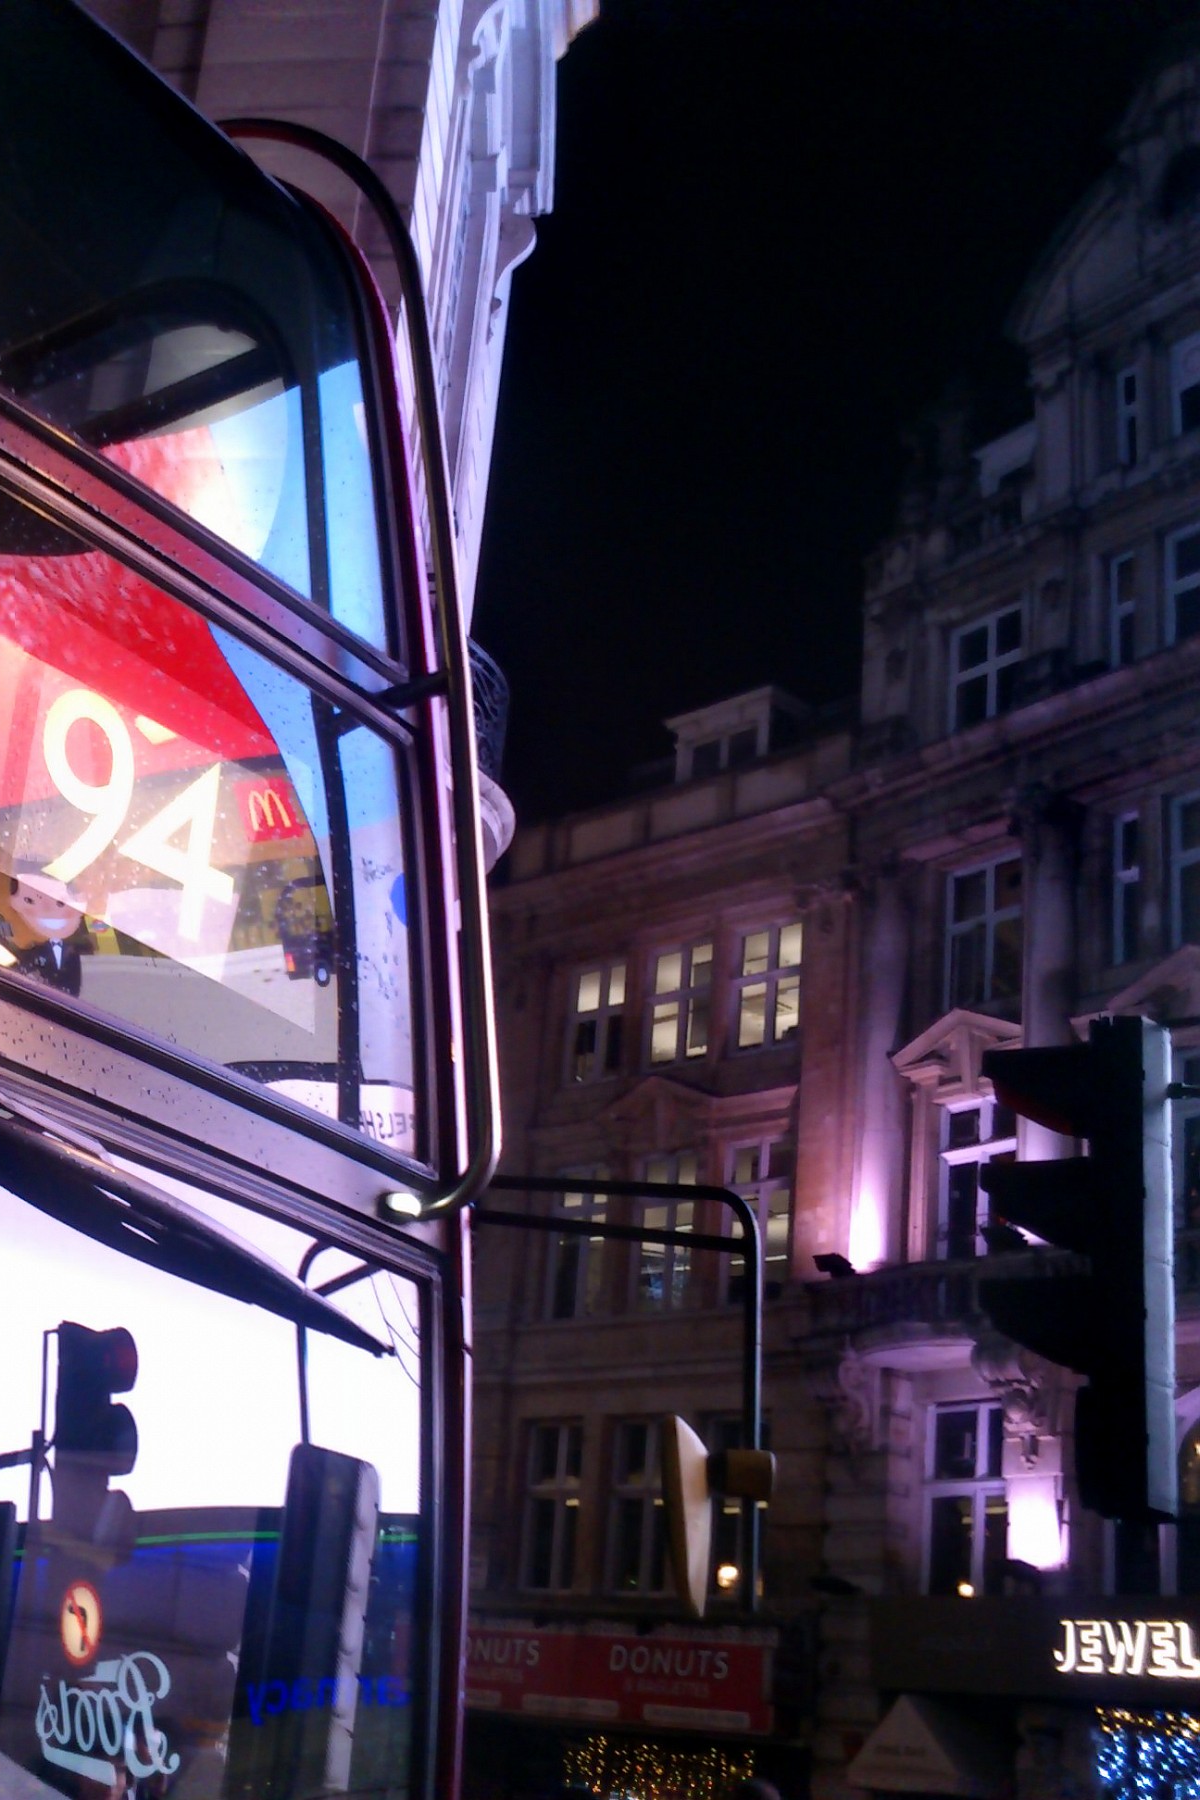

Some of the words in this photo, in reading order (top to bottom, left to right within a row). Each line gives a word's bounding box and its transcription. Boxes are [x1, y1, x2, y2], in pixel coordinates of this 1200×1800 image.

[41, 688, 235, 943] 94
[609, 1645, 730, 1679] DONUTS
[1052, 1619, 1200, 1679] JEWEL
